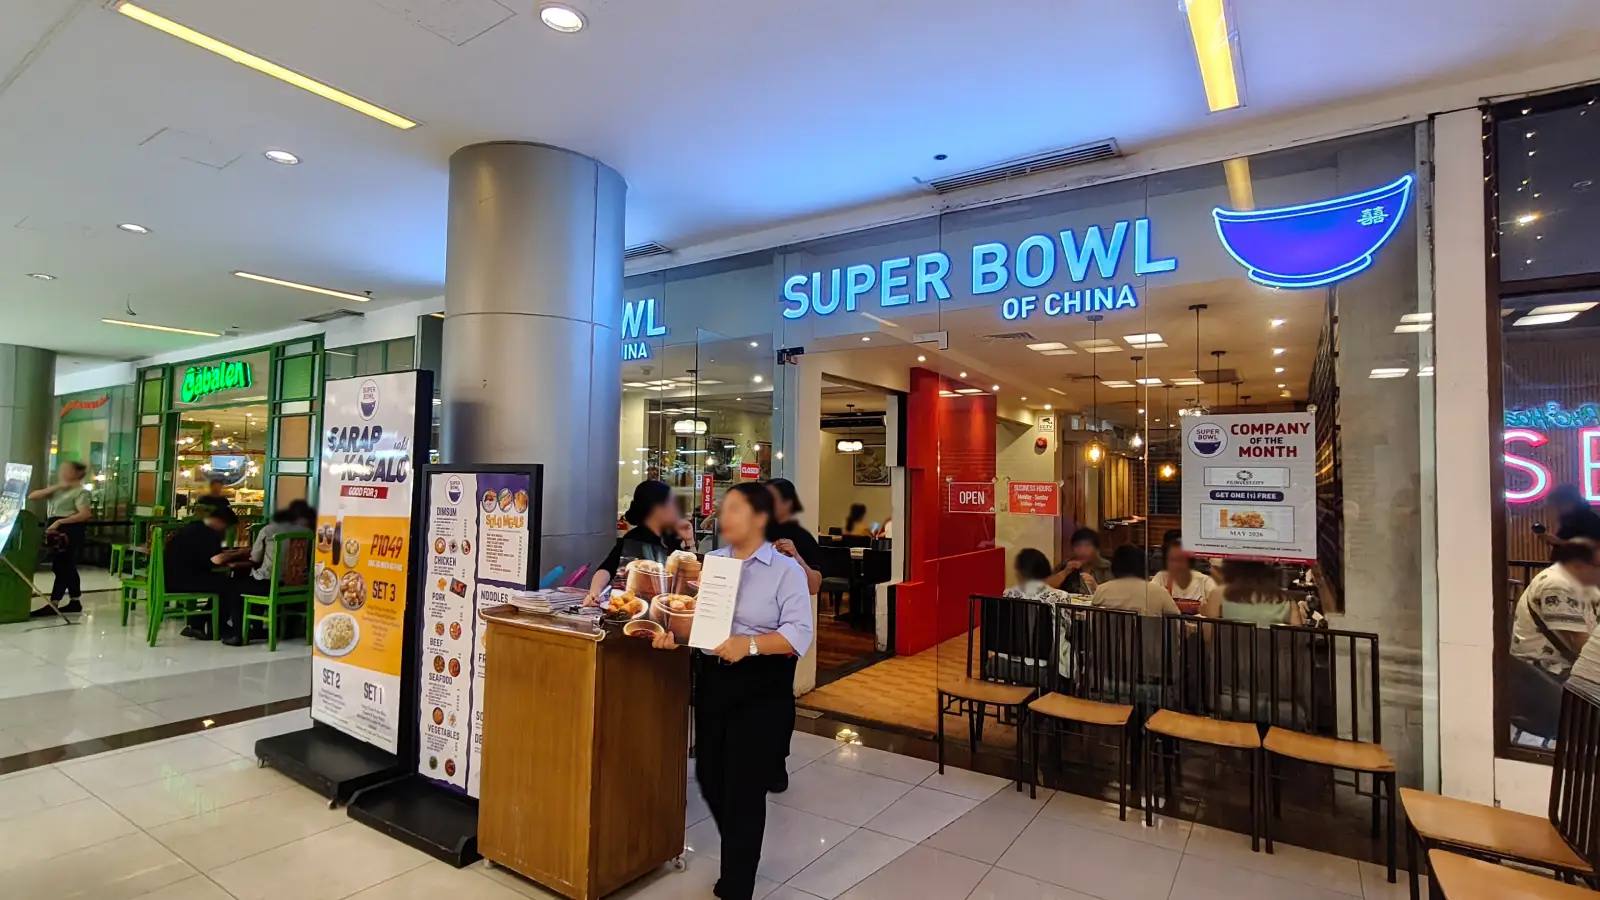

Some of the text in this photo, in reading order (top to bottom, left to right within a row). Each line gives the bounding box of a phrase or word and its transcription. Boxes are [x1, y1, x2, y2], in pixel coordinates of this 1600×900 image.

[783, 218, 1176, 319] SUPER BOWL
[1002, 284, 1137, 320] OF CHINA
[621, 342, 648, 360] INA
[1231, 422, 1310, 435] COMPANY
[328, 425, 382, 452] SARAP
[1250, 437, 1284, 445] OF THE
[1238, 445, 1298, 458] MONTH
[349, 486, 379, 498] GOOD FOR 3
[959, 491, 985, 505] OPEN
[436, 507, 457, 516] DIMSUM
[486, 514, 501, 529] SOLO
[434, 555, 457, 567] CHICKEN
[373, 580, 396, 603] SET 3
[432, 592, 445, 602] PORK
[480, 590, 509, 604] NOODLES
[430, 637, 444, 647] BEEF
[323, 668, 341, 689] SET 2
[429, 672, 453, 685] SEAFOOD
[364, 682, 378, 702] SET
[428, 724, 460, 741] VEGETABLES
